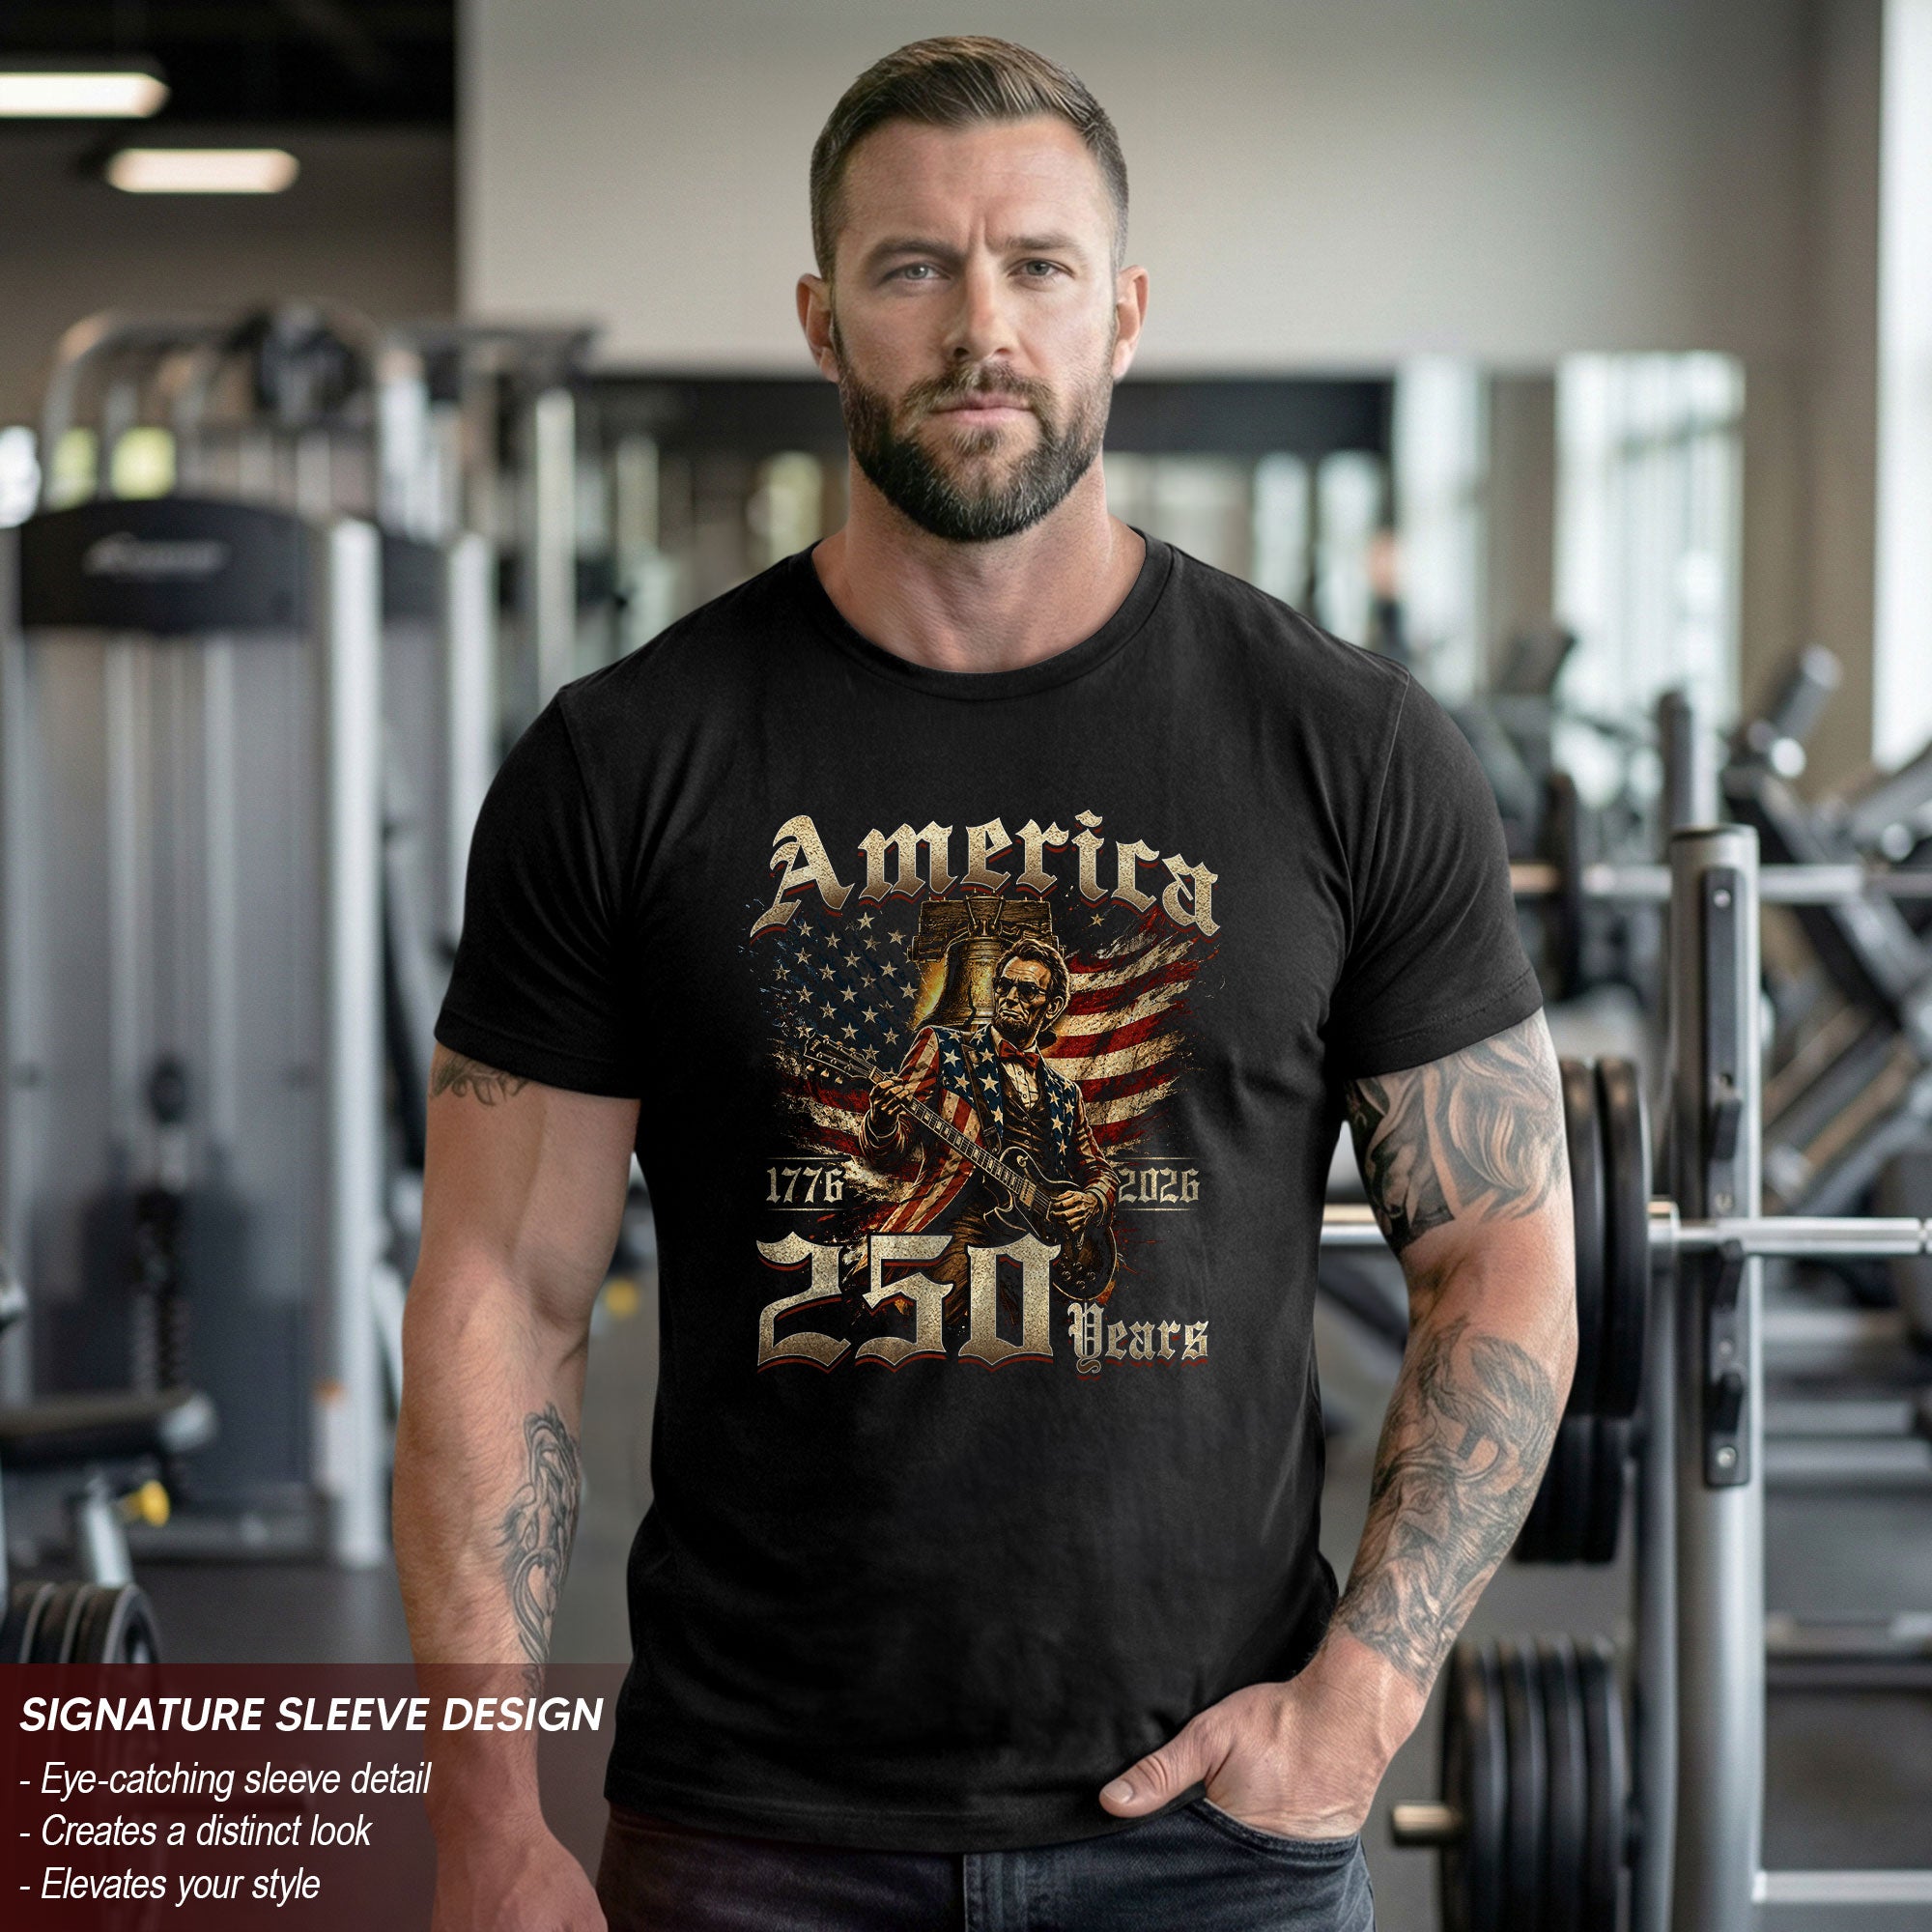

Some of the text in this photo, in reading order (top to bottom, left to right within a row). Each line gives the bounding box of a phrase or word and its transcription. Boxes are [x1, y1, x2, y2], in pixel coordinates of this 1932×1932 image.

[750, 810, 1221, 937] America
[766, 1167, 845, 1204] 1776
[1117, 1167, 1200, 1204] 2026
[756, 1230, 1209, 1376] 250 Years
